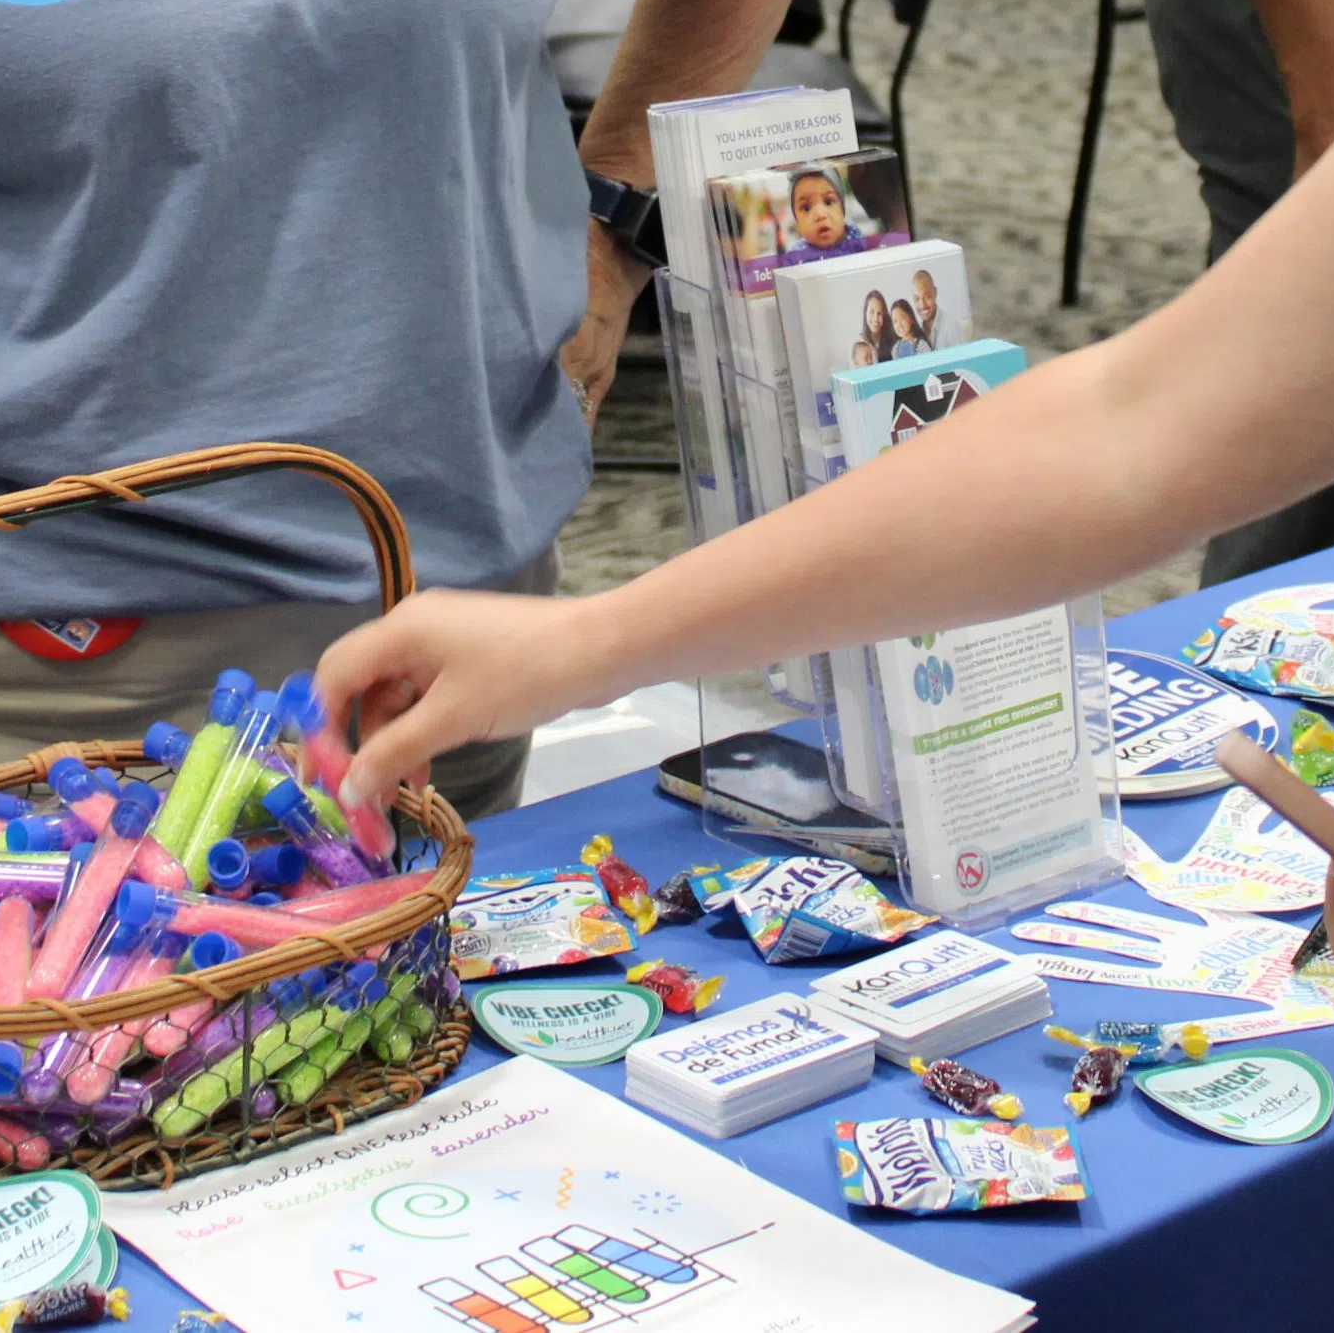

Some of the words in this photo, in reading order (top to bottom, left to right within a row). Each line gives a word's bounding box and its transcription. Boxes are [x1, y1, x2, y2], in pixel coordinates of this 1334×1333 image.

[715, 133, 736, 146] YOU
[738, 127, 764, 141] HAVE
[765, 123, 793, 137] YOUR
[794, 113, 843, 132] REASONS
[719, 151, 734, 163] TO
[735, 146, 759, 161] QUIT
[760, 140, 792, 156] USING
[792, 131, 844, 149] TOBACCO.
[1197, 844, 1267, 865] care
[1184, 855, 1317, 892] provider
[841, 939, 980, 998] KanQuit!
[490, 1001, 542, 1020] VIBE
[543, 993, 625, 1020] CHECK!
[509, 1013, 566, 1027] WELLNESS
[568, 1016, 580, 1027] IS
[583, 1015, 592, 1024] A
[594, 1008, 618, 1022] VIBE
[554, 1018, 638, 1043] healthier
[686, 1055, 726, 1074] de
[719, 1027, 804, 1061] Fumar
[1194, 1062, 1267, 1102] CHECK!
[164, 1181, 256, 1219] Please
[256, 1154, 336, 1191] select
[332, 1139, 389, 1165] ONE
[386, 1122, 441, 1155] test
[438, 1098, 500, 1130] tube
[865, 1117, 939, 1203] Welch's
[14, 1225, 23, 1238] A
[27, 1207, 54, 1231] VIBE
